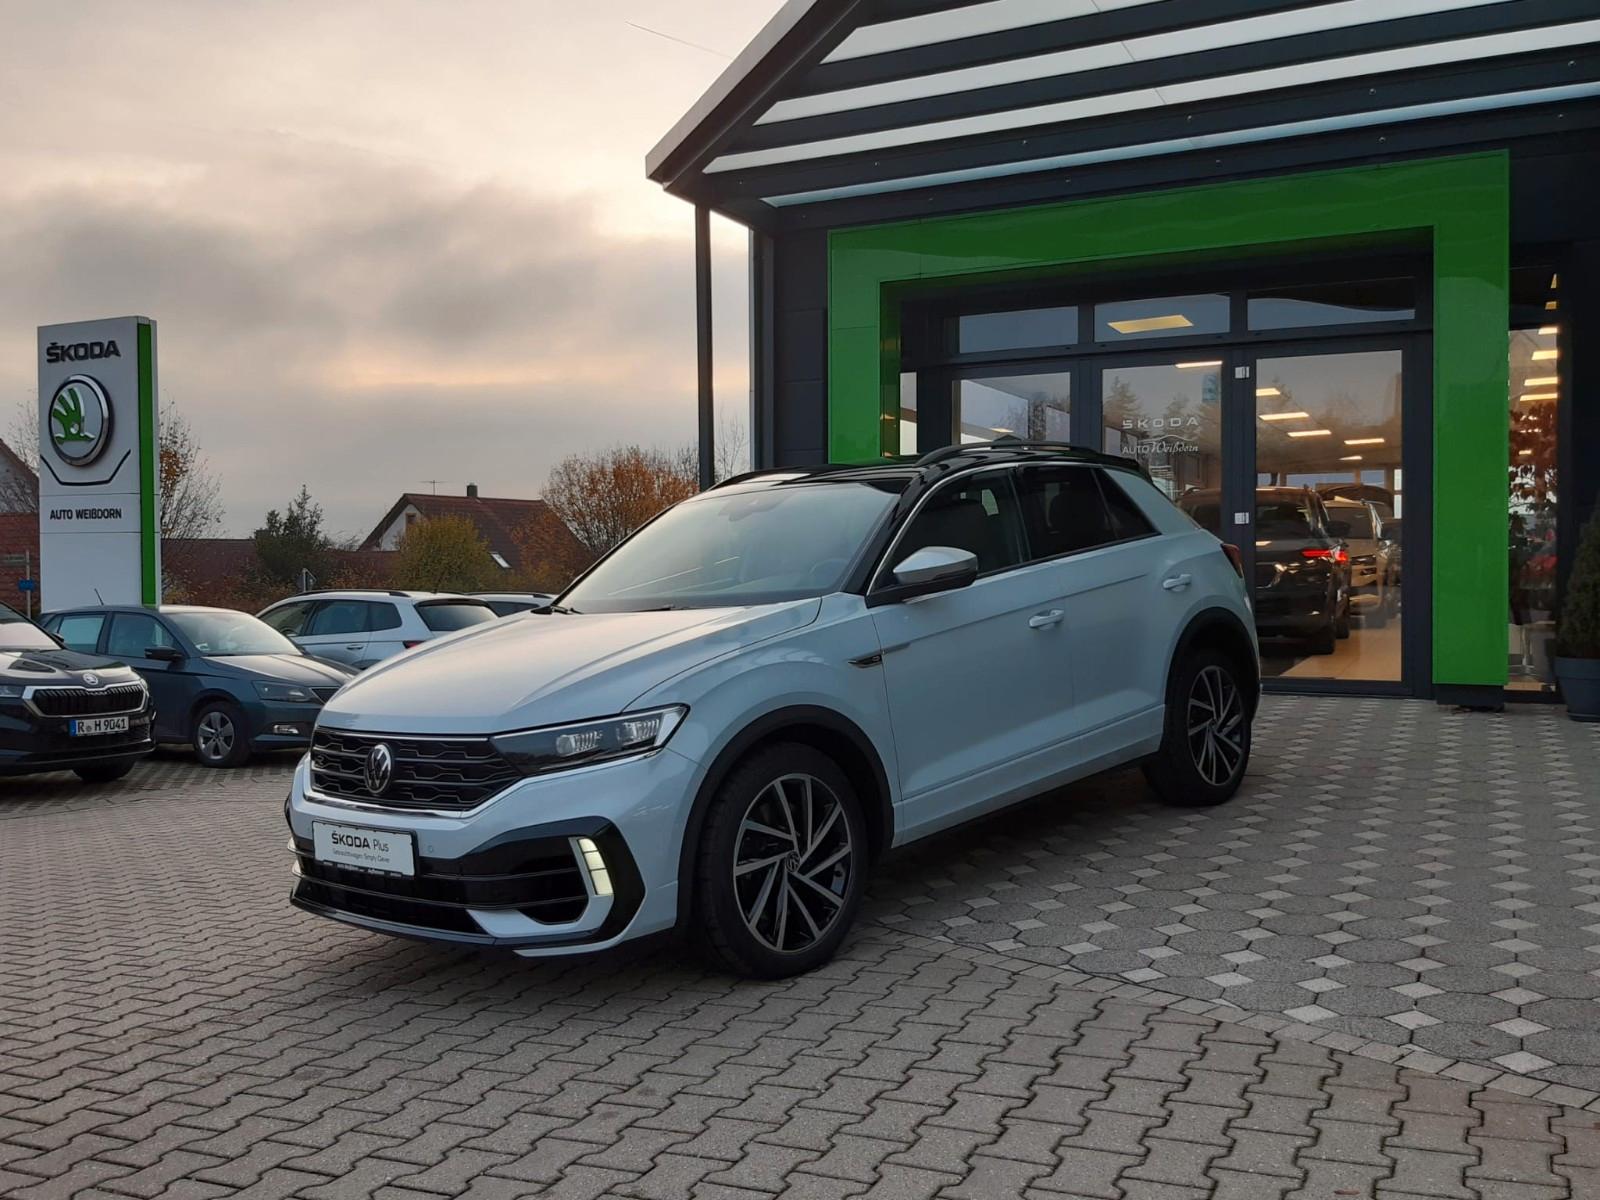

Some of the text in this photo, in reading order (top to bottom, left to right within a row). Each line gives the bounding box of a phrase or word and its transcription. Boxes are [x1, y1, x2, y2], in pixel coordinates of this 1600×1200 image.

[46, 340, 121, 363] ŠKODA
[1122, 445, 1150, 454] AUTO
[50, 509, 73, 520] AUTO
[78, 718, 127, 733] R H 9041
[373, 838, 390, 853] Plus
